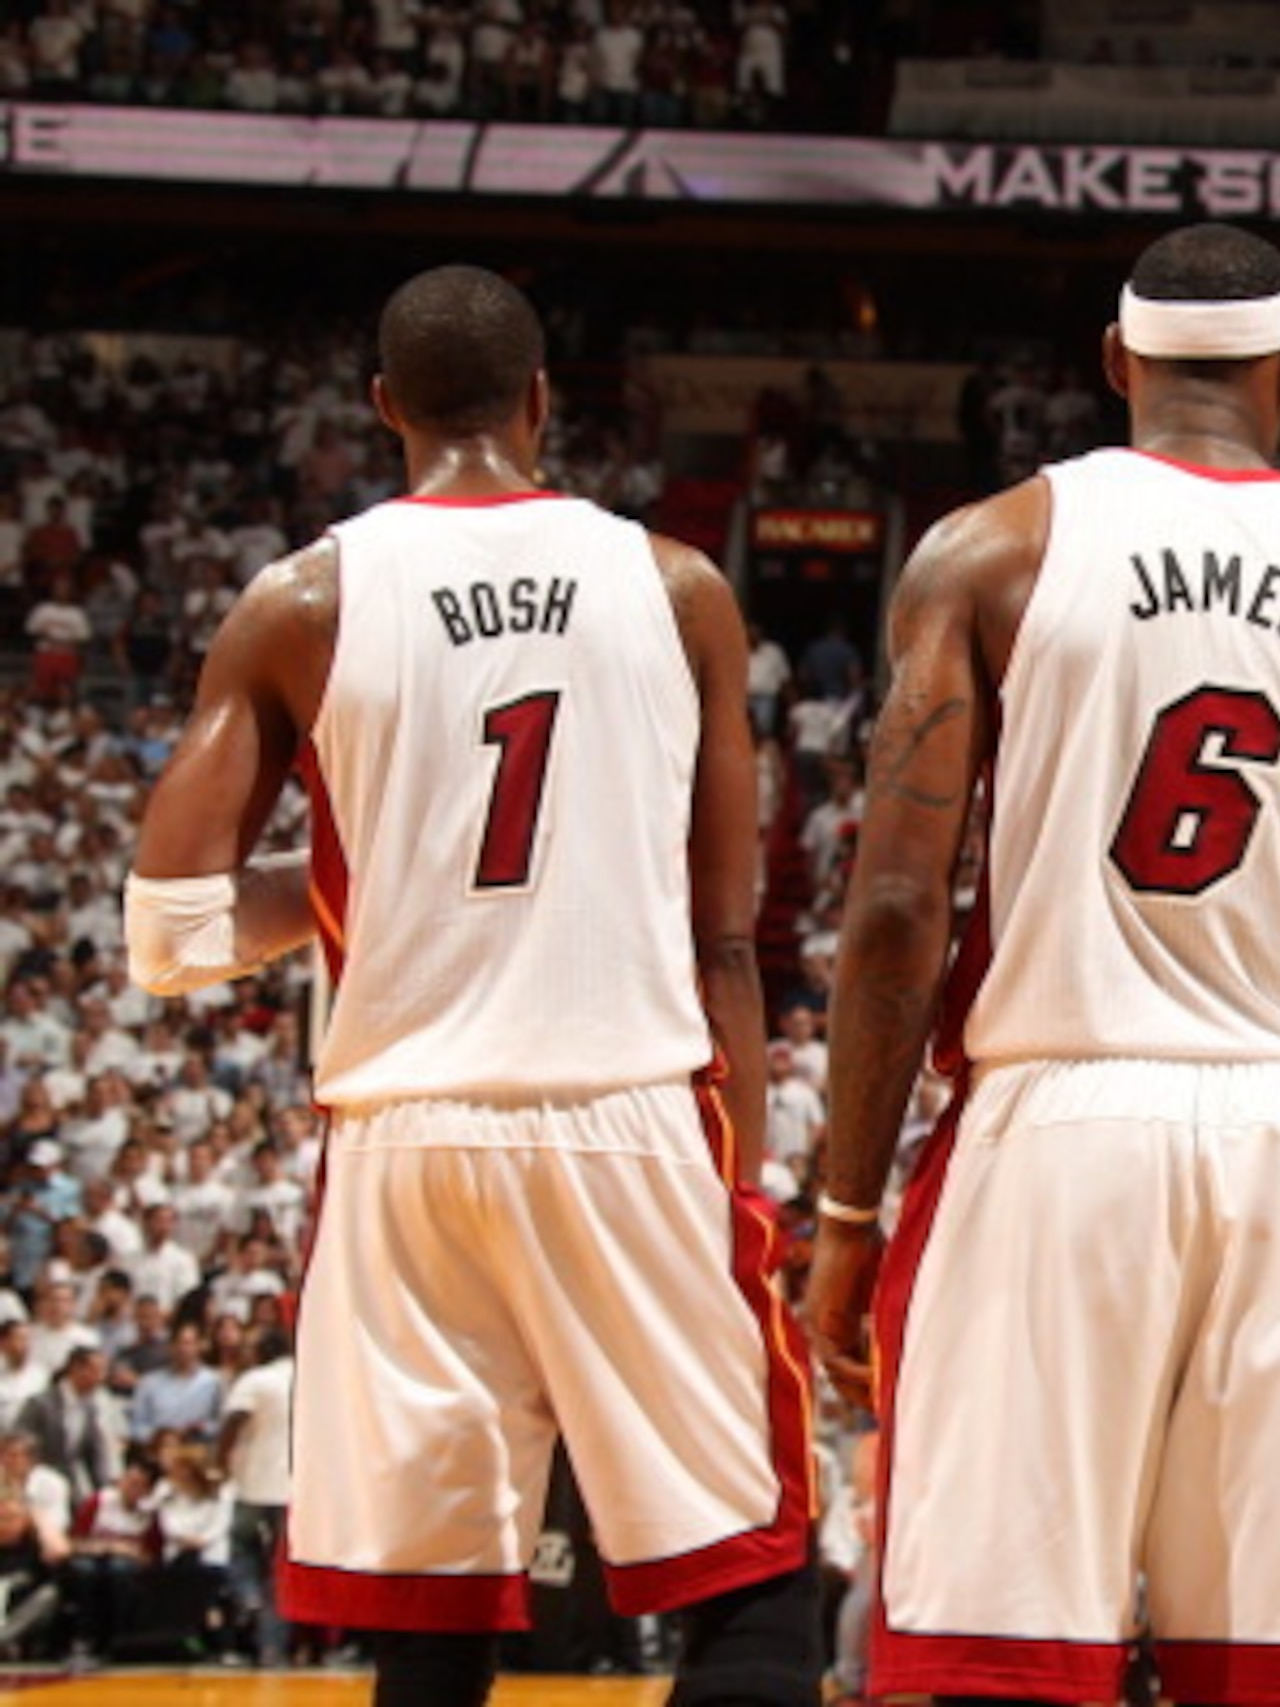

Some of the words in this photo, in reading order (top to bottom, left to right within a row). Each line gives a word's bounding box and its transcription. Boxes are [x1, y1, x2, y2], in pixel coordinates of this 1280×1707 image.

[0, 107, 70, 163] E
[924, 146, 1182, 209] MAKE
[431, 577, 578, 647] BOSH
[473, 690, 561, 888] 1
